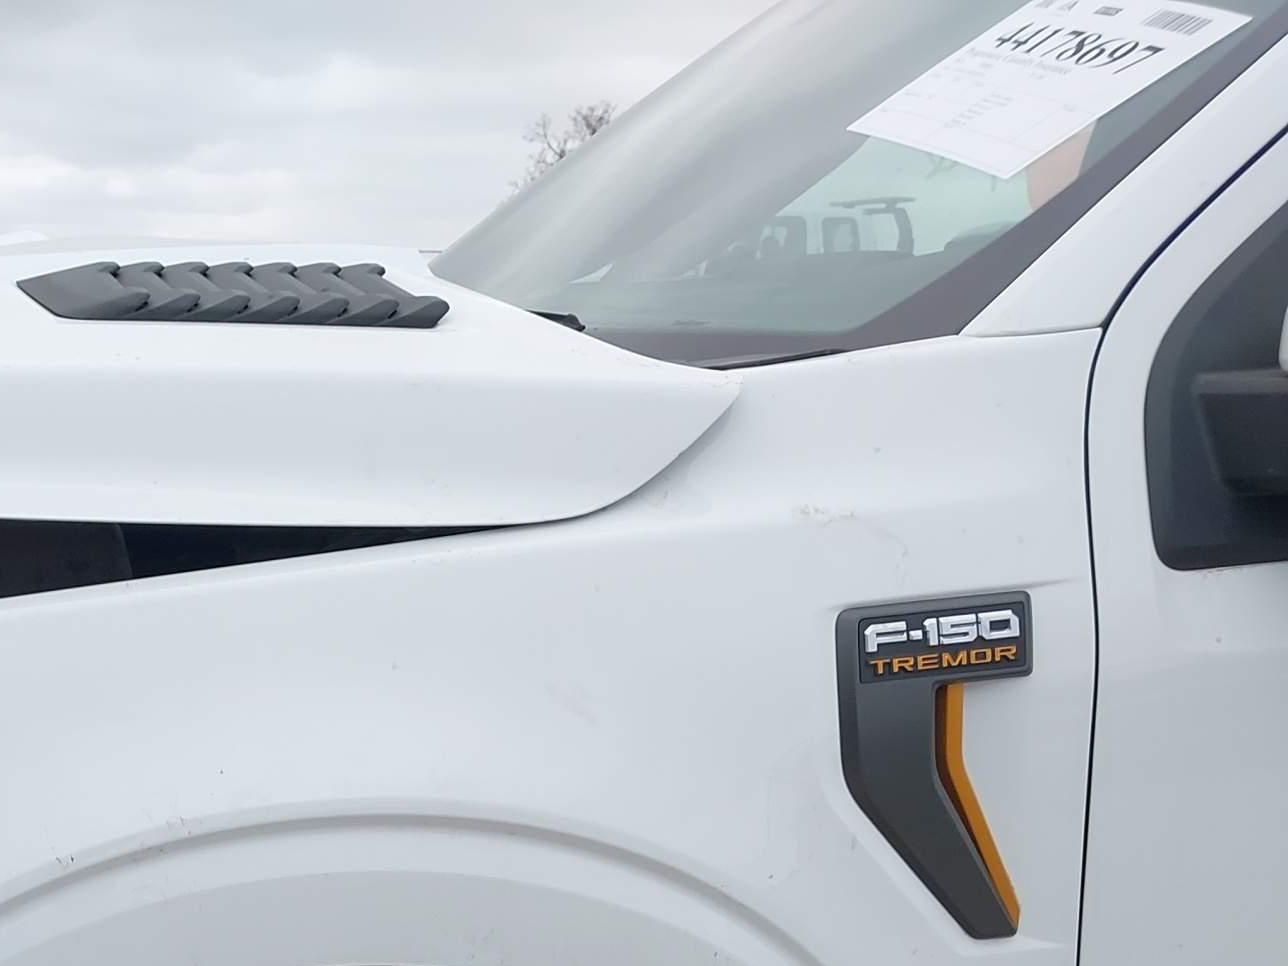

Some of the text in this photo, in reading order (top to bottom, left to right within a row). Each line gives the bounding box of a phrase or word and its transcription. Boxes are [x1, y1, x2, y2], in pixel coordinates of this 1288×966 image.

[995, 22, 1166, 75] 44178697
[864, 609, 1020, 653] F-150
[868, 645, 1017, 674] TREMOR
